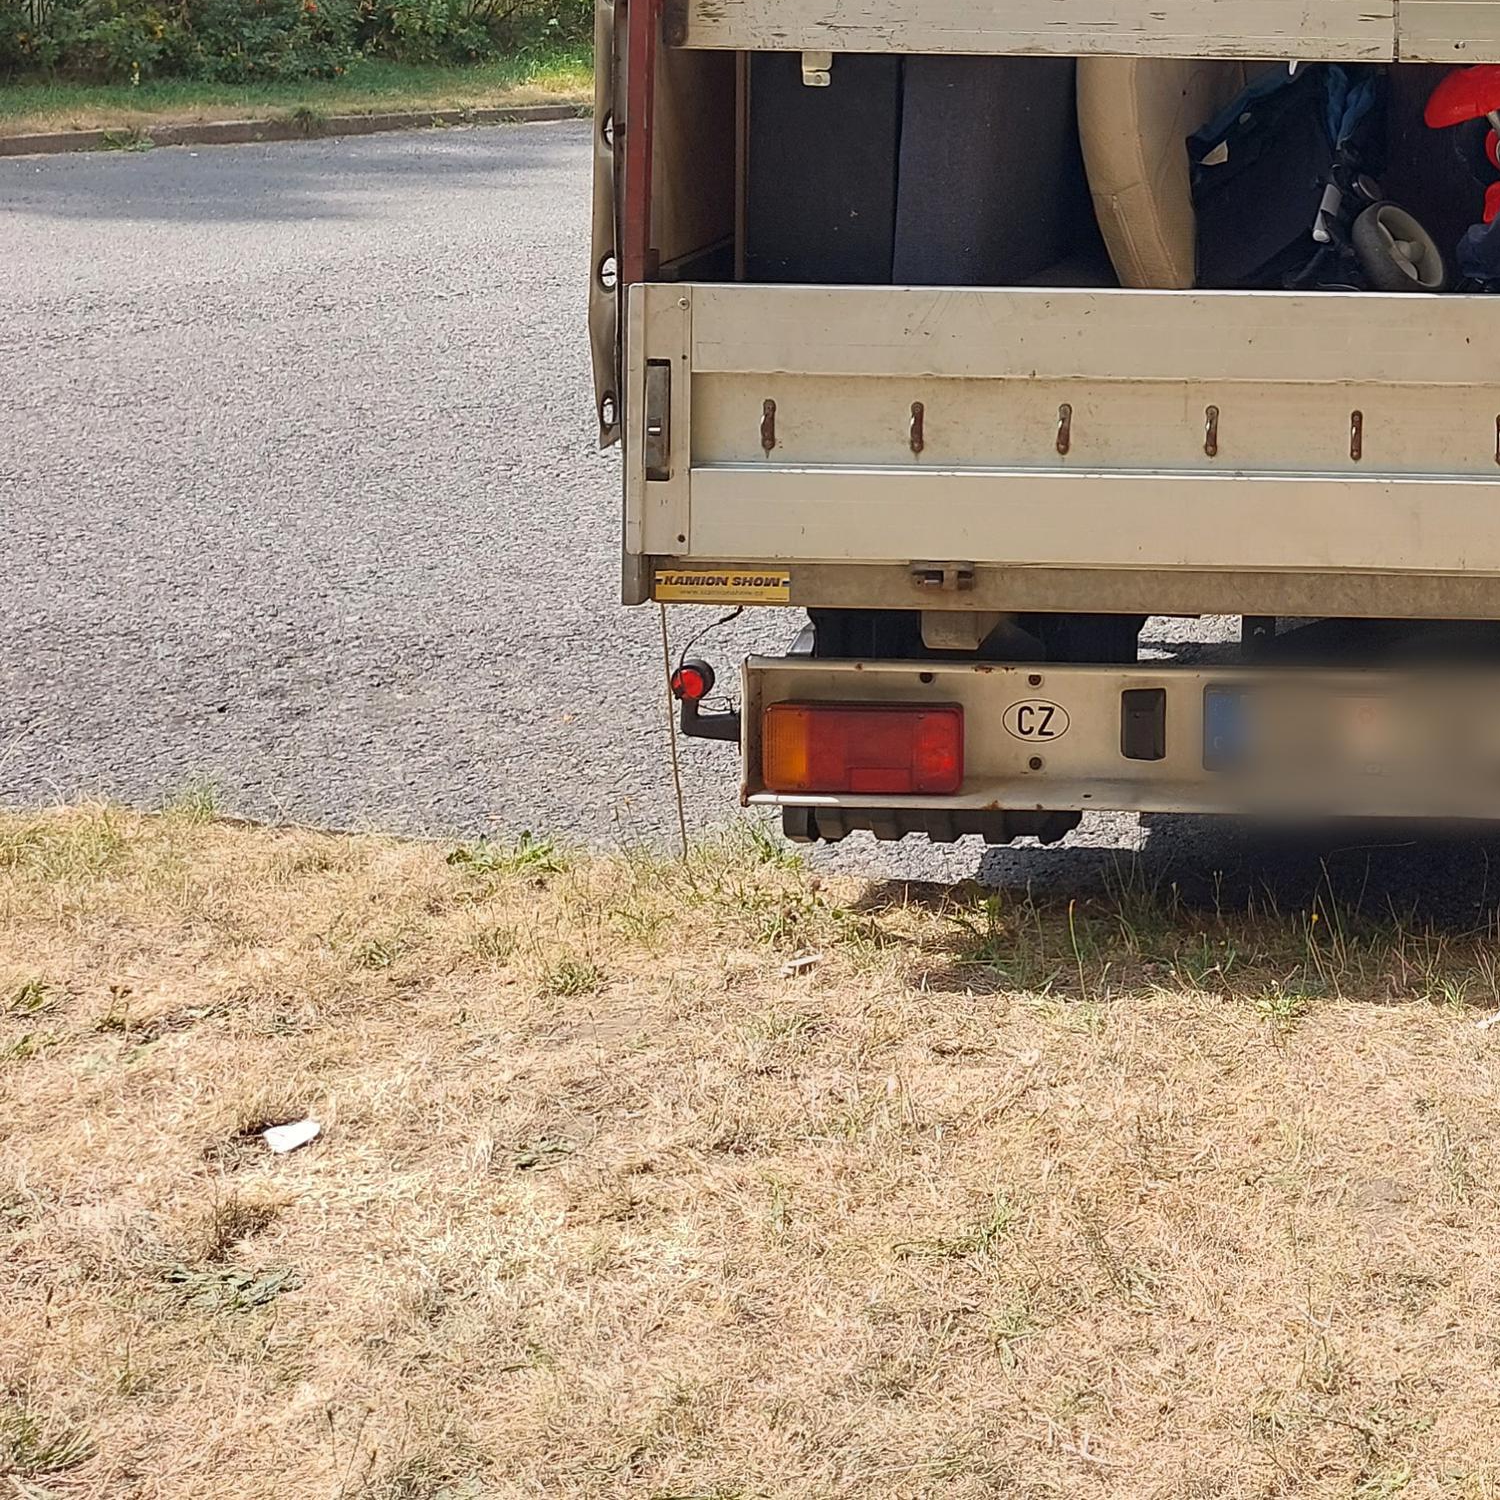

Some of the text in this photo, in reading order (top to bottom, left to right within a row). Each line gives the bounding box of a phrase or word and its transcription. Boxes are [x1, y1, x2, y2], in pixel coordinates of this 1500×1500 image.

[664, 575, 780, 587] KAMION SHOW
[1018, 706, 1055, 736] CZ
